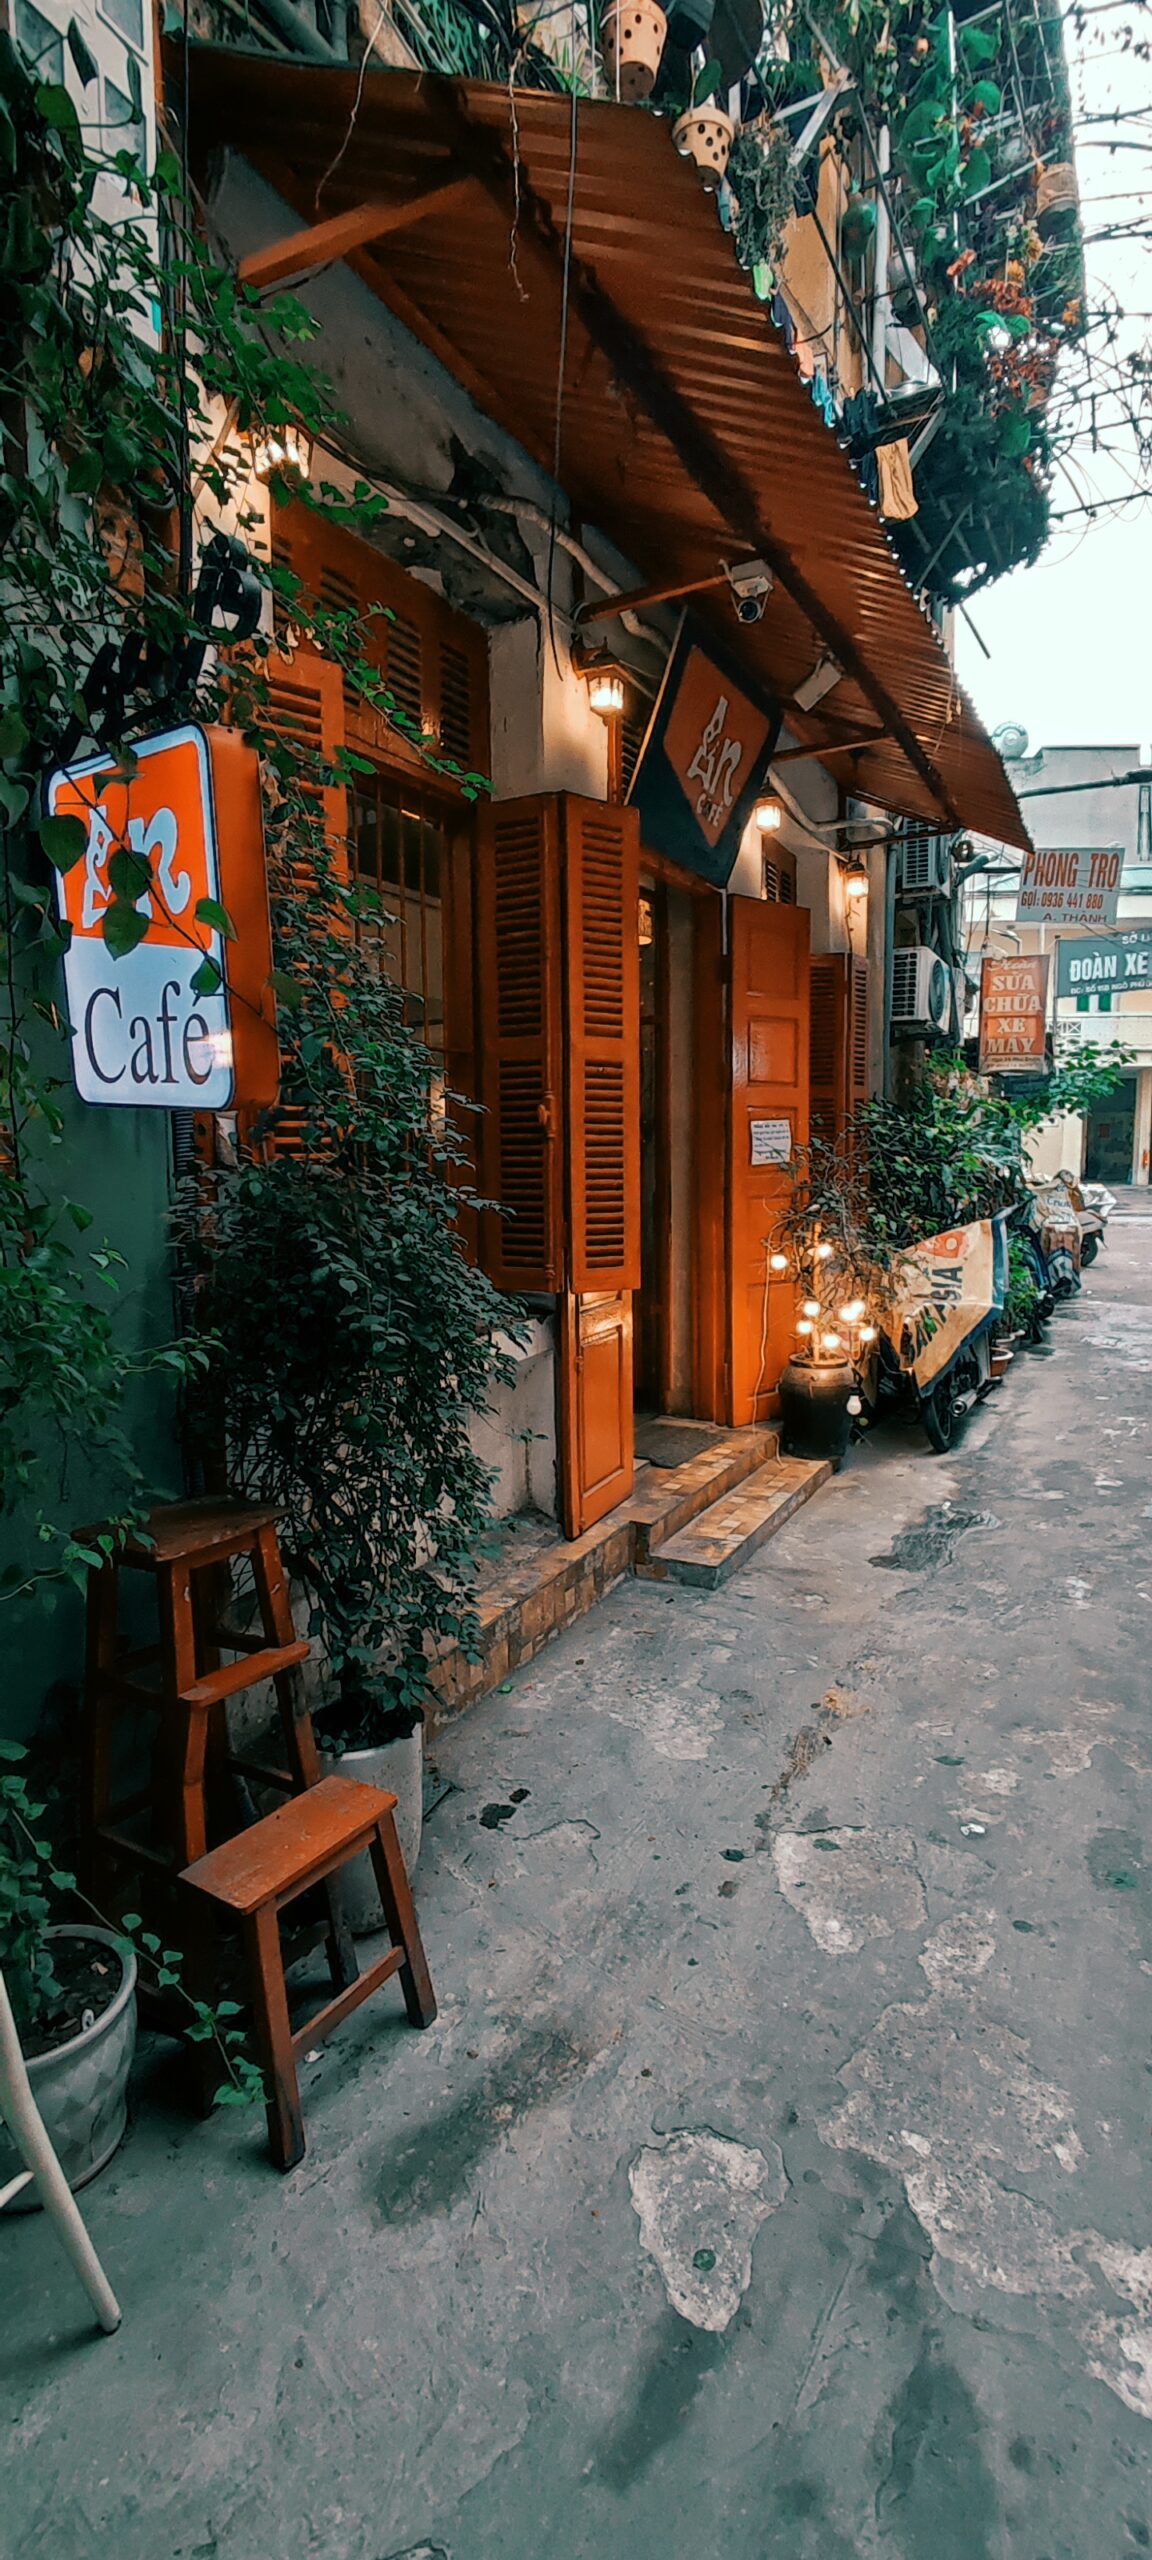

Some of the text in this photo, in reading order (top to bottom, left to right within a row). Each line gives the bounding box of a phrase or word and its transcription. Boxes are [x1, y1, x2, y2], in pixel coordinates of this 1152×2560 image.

[1088, 852, 1119, 891] TRỌ
[1041, 892, 1064, 907] 0936
[1067, 893, 1083, 908] 441
[1086, 893, 1103, 909] 880
[1069, 952, 1148, 982] ĐOÀN XE
[992, 971, 1034, 992] SỬA
[983, 992, 1043, 1013] CHỮA
[84, 980, 213, 1085] Café
[997, 1017, 1025, 1033] XE
[987, 1035, 1036, 1053] MÁY
